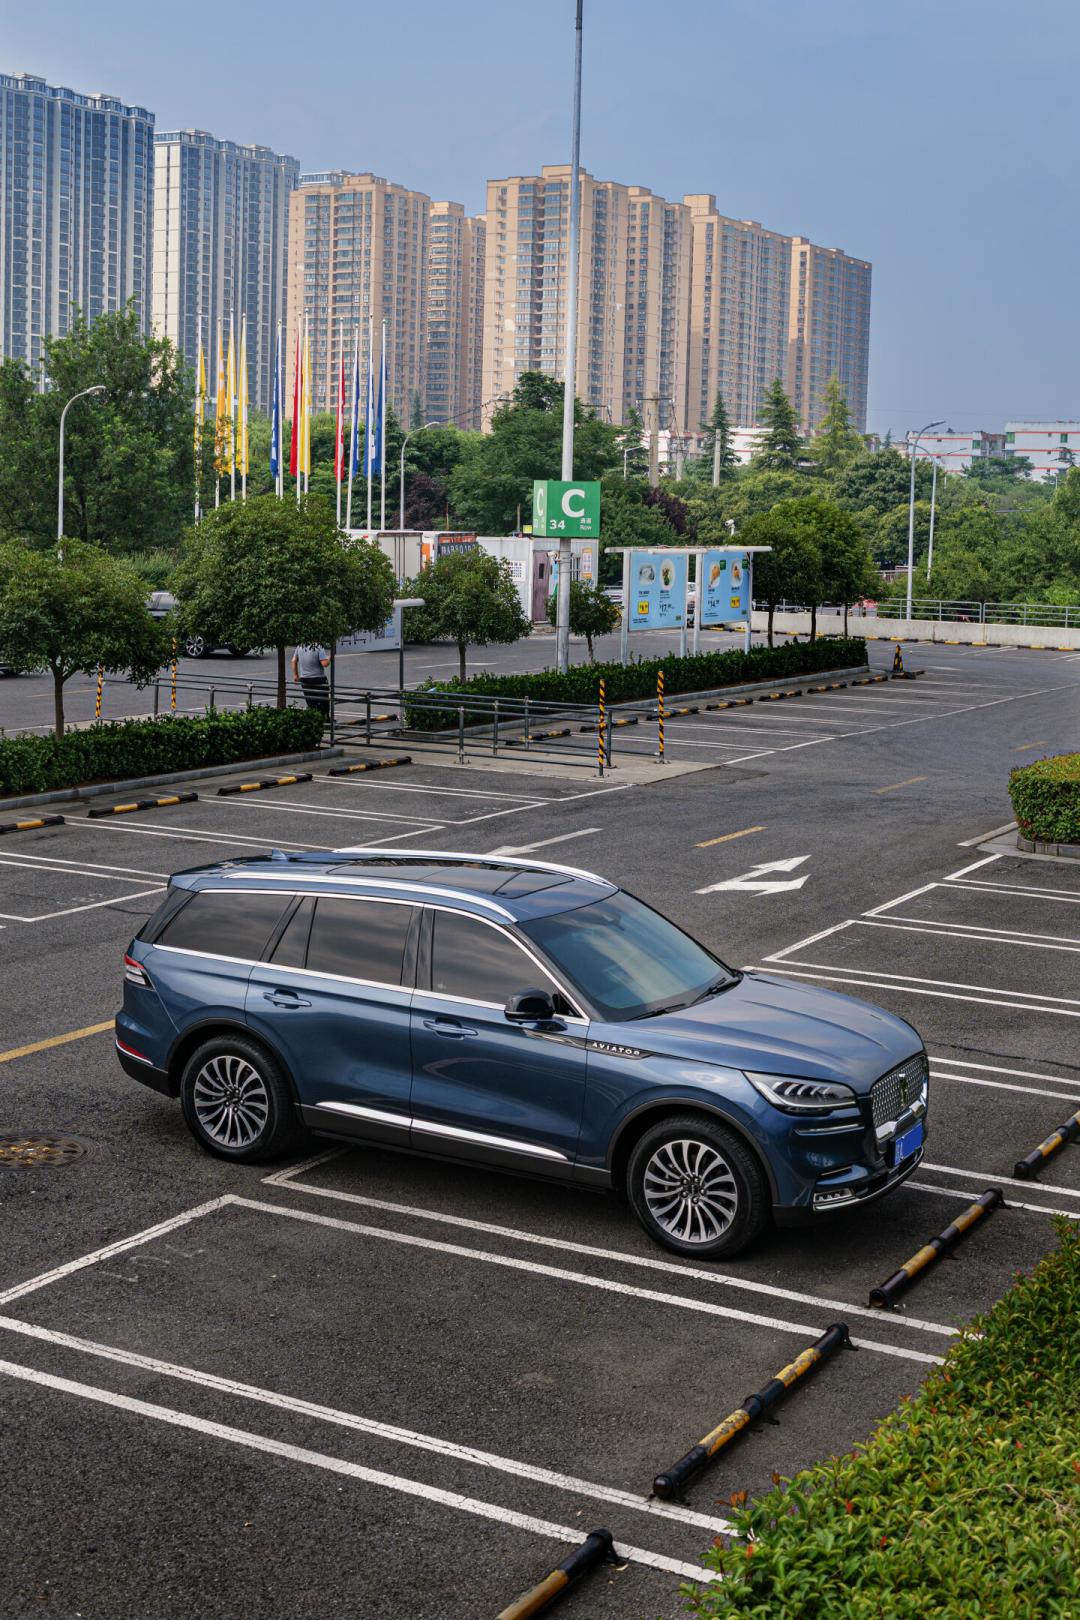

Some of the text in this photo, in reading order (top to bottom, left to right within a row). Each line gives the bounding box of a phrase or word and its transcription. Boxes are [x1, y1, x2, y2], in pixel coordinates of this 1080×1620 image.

[561, 488, 585, 518] C
[549, 519, 566, 530] 34
[592, 1041, 640, 1057] AVIATOR
